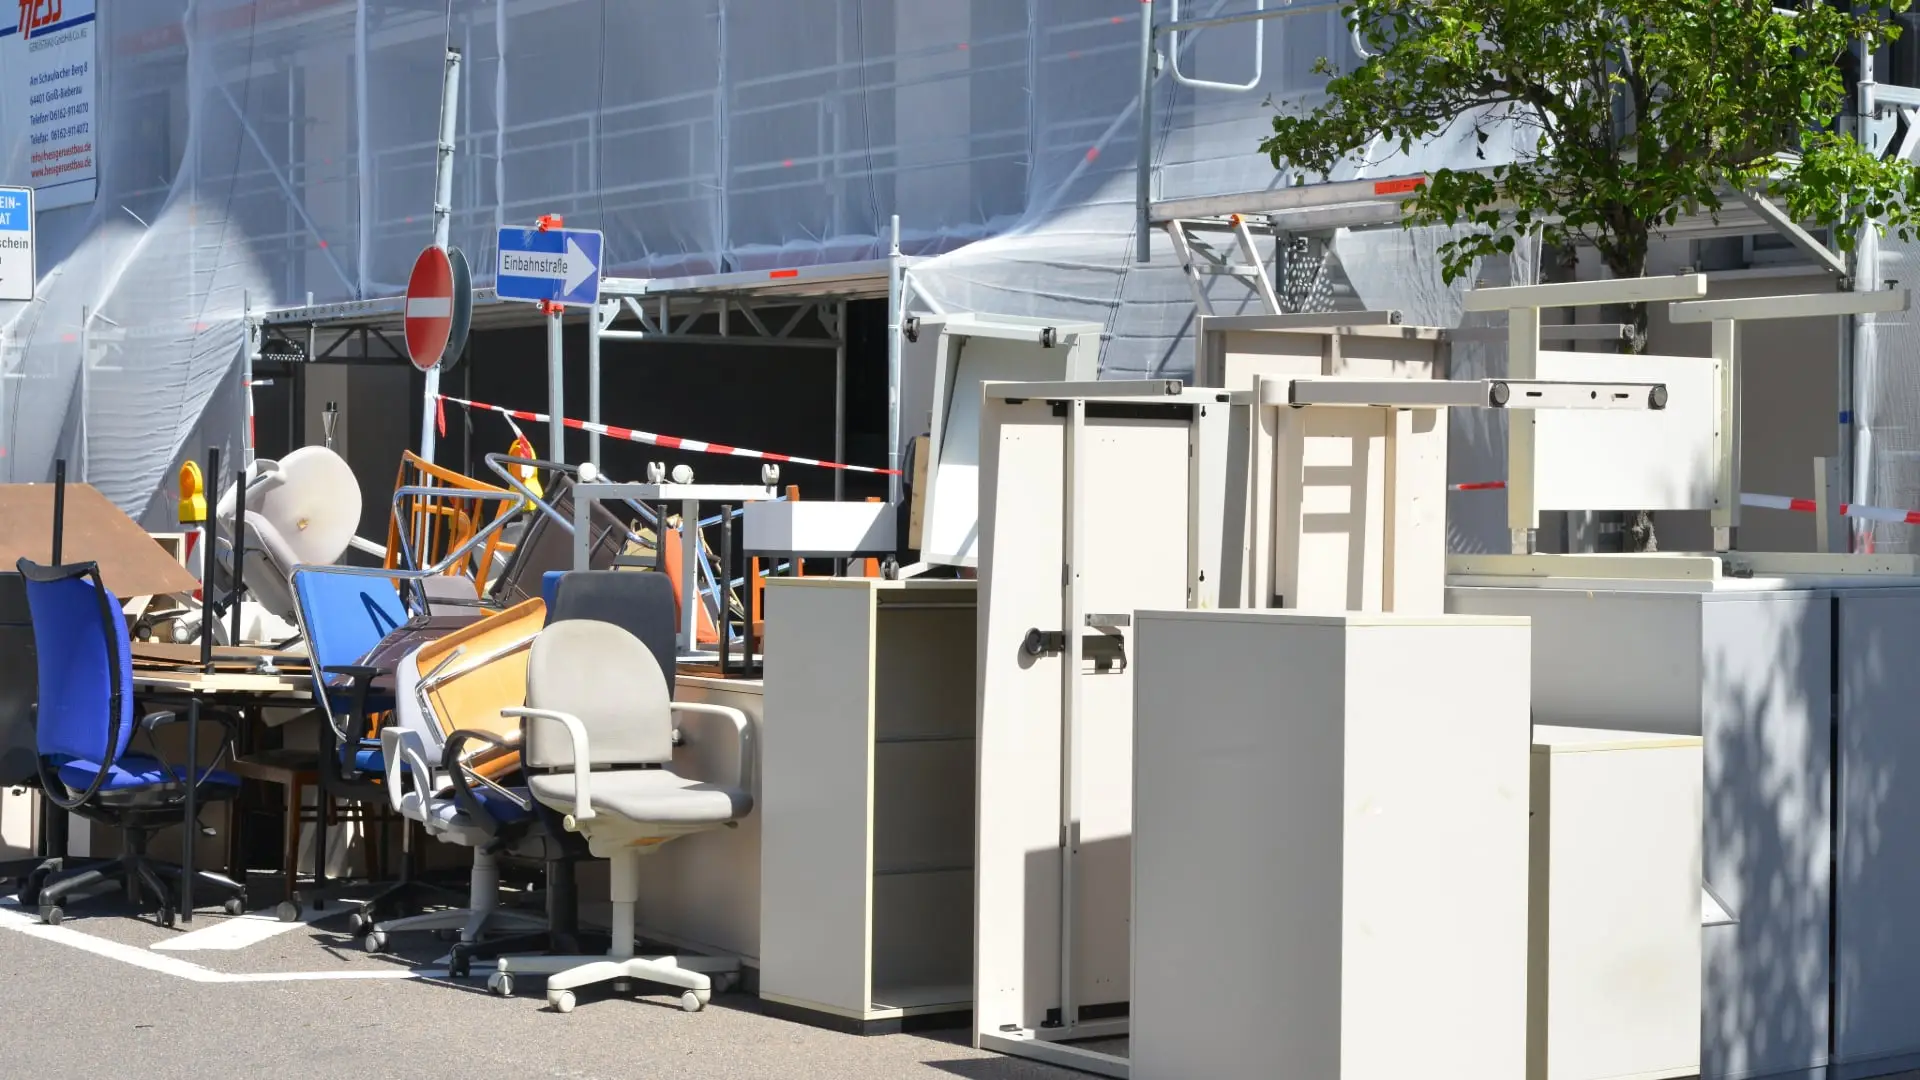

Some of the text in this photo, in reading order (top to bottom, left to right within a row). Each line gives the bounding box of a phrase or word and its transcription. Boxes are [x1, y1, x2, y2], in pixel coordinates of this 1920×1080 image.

[30, 76, 38, 86] Am
[71, 64, 83, 76] Berg
[84, 61, 88, 72] 8
[504, 255, 568, 273] Einbahnstraße
